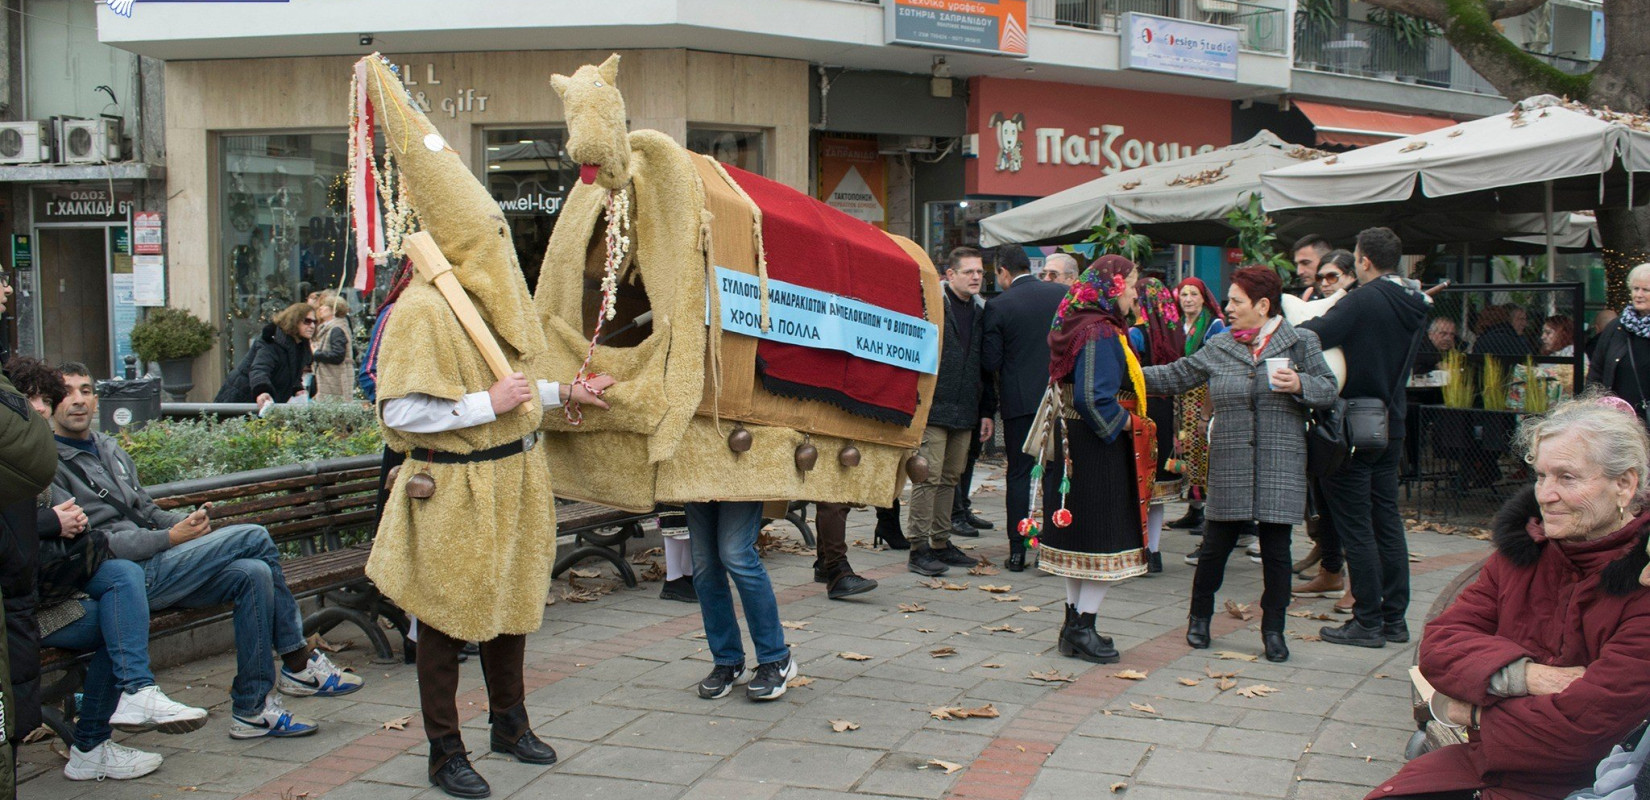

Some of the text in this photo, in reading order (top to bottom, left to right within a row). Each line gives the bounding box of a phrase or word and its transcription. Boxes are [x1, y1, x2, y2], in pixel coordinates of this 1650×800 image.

[947, 2, 985, 13] γραφείο
[899, 8, 992, 27] ΣΩΤΗΡΙΑ ΣΑΠΡΑΝΙΔΟΥ
[1200, 39, 1232, 53] Studio
[70, 191, 106, 200] ΟΔΟΣ
[46, 201, 115, 216] Γ.ΧΑΛΚΙΔΗ
[722, 278, 762, 301] ΣΥΛΛΟΓΟΣ
[730, 308, 821, 340] ΧΡΟΝΑ ΠΟΛΛΑ
[856, 336, 921, 364] ΚΑΛΗ ΧΡΟΝΙΑ
